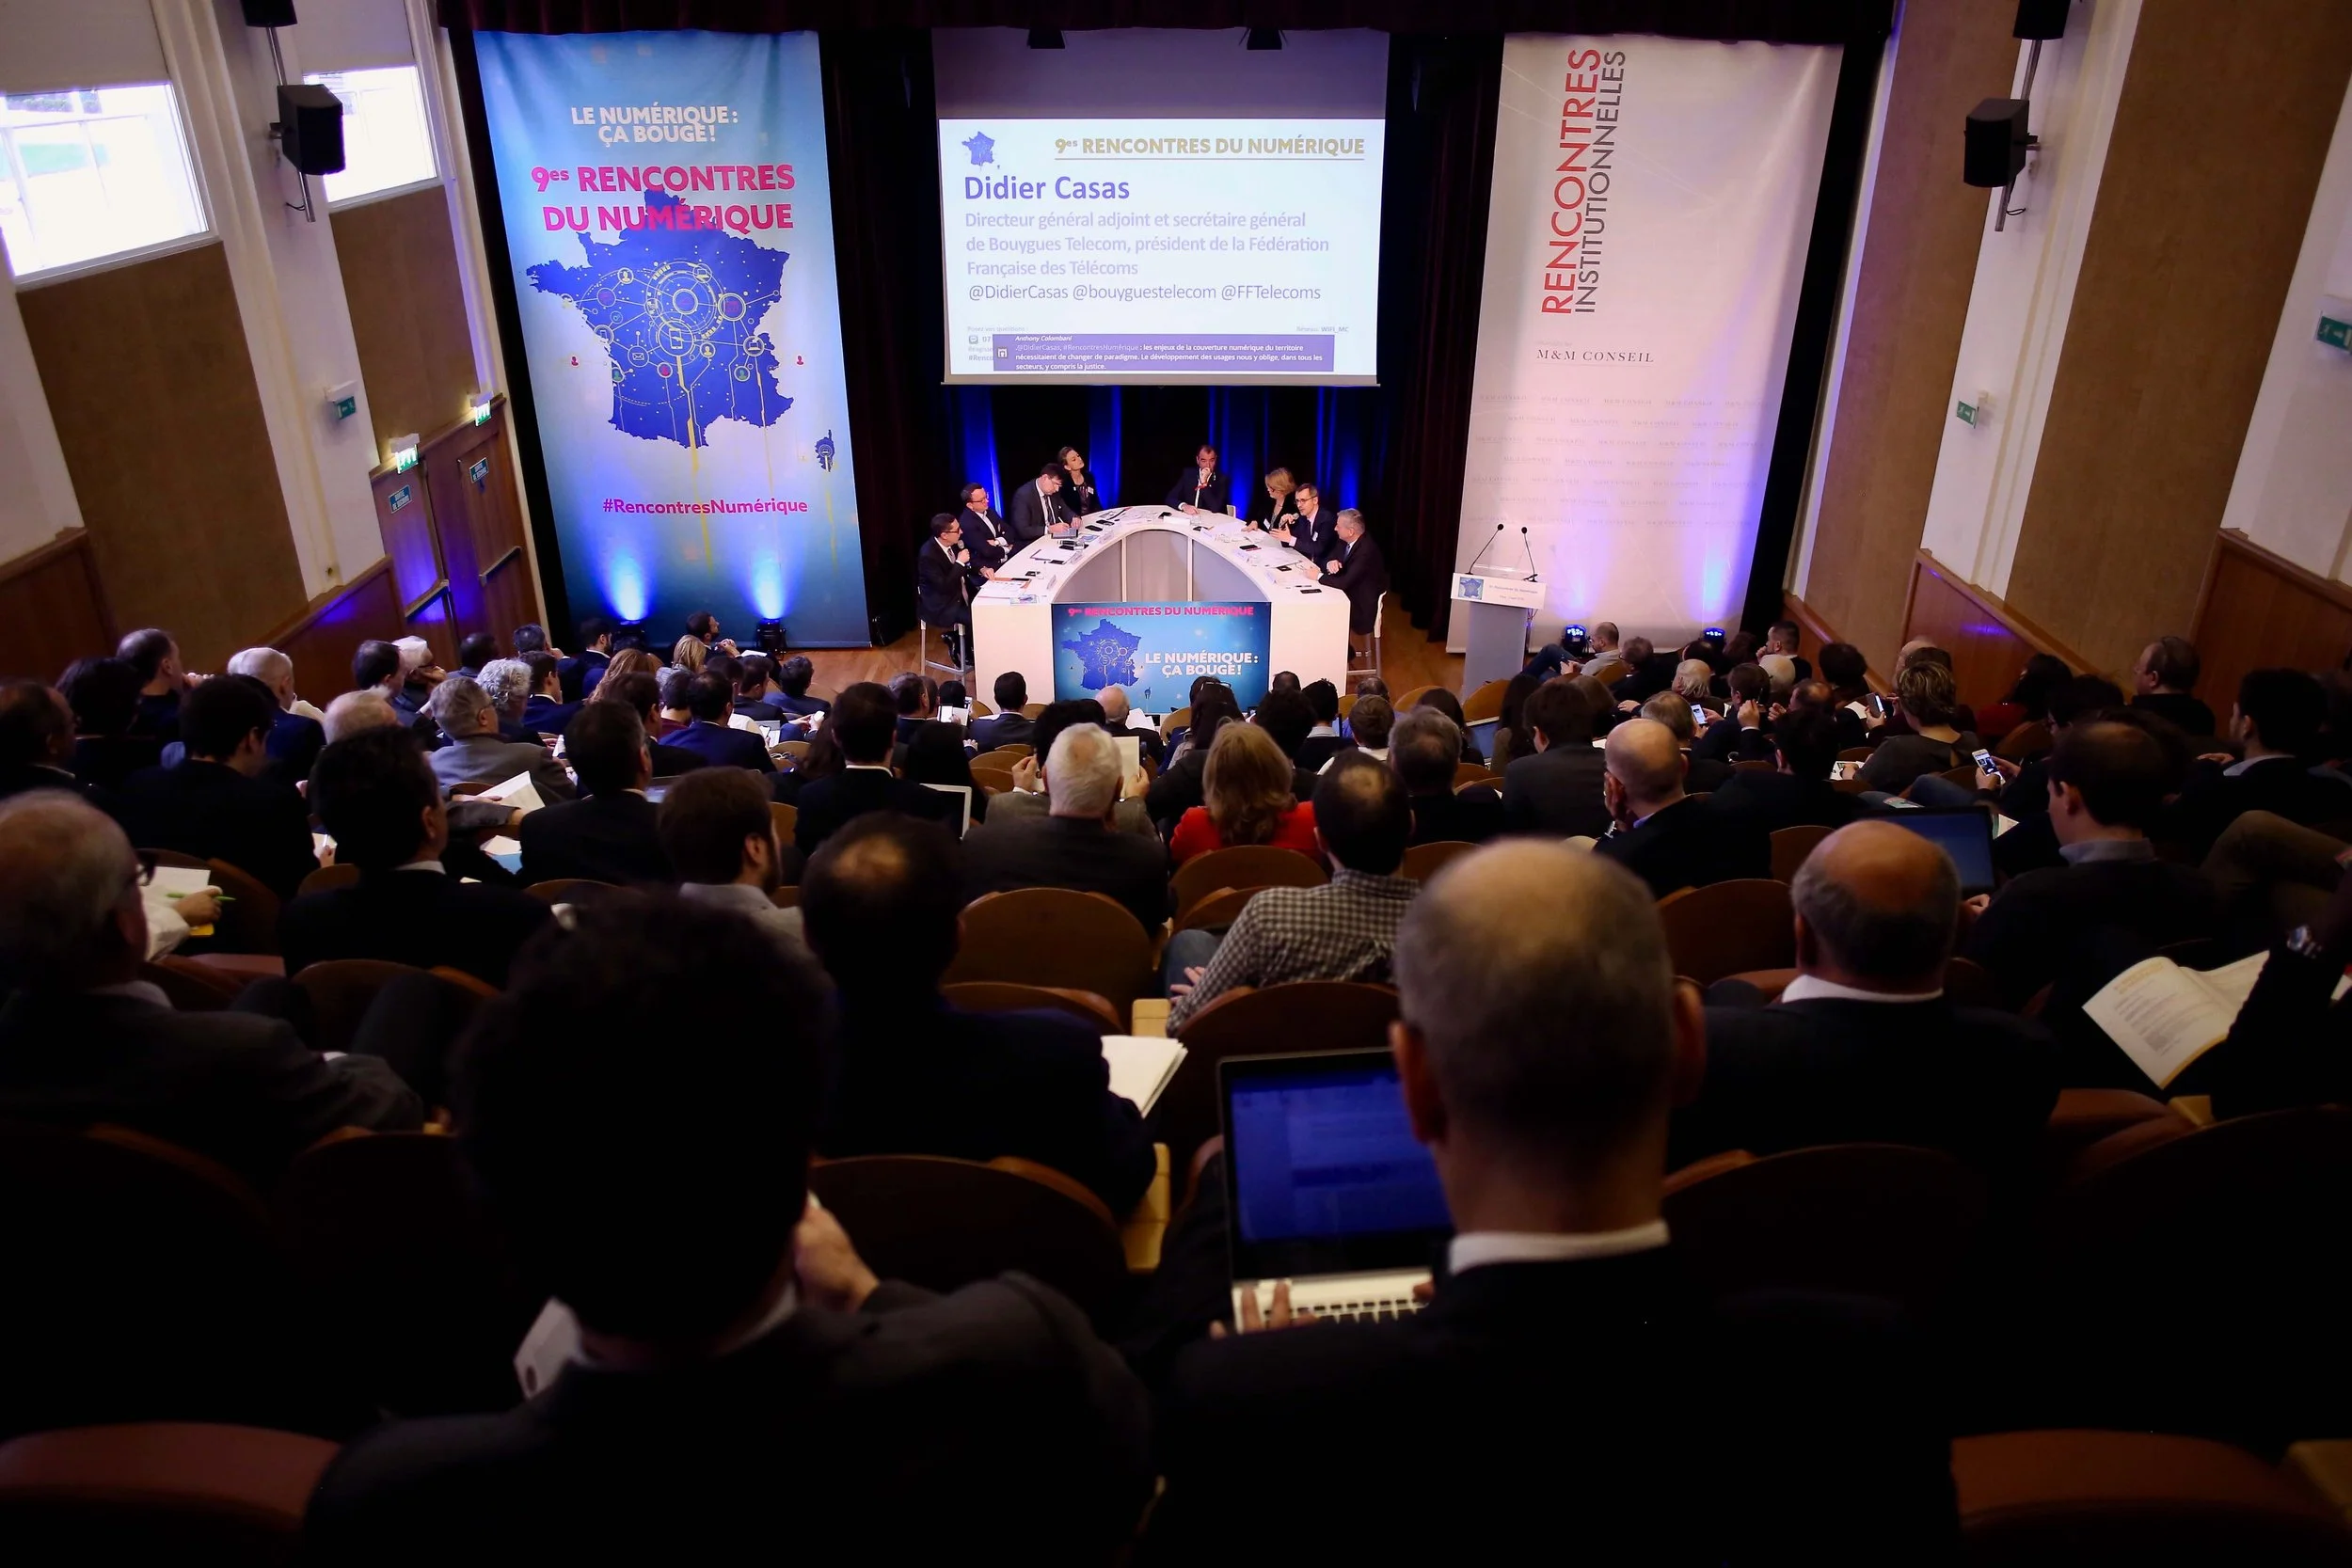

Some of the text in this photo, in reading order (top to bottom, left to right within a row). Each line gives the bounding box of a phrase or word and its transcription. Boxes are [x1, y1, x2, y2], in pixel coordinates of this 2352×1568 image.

[571, 107, 595, 125] LE
[598, 125, 629, 148] ÇA
[1055, 134, 1365, 156] 9es RENCONTRES DU NUMÉRIQUE
[532, 165, 796, 192] 9es RENCONTRES
[964, 175, 1130, 199] Didier Casas
[1541, 48, 1601, 313] RENCONTRES
[1575, 51, 1626, 313] INSTITUTIONNELLES
[543, 198, 794, 234] DU NUMÉRIQUE
[965, 212, 1306, 230] Directeur général adjoint et secrétaire général
[966, 236, 1329, 254] de Bouygues Telecom, président de la Fédération
[967, 260, 1138, 277] Française des Télécoms
[969, 284, 1321, 302] @DidierCasas @bouyguestelecom @FFTelecoms
[1536, 349, 1654, 363] M&M CONSEIL
[1050, 363, 1076, 372] compris
[1084, 363, 1106, 372] justice.
[603, 498, 808, 515] #RencontresNumérique
[1084, 607, 1161, 617] RENCONTRES
[1164, 606, 1182, 616] DU
[1145, 653, 1161, 664] LE
[1162, 664, 1183, 678] ÇA
